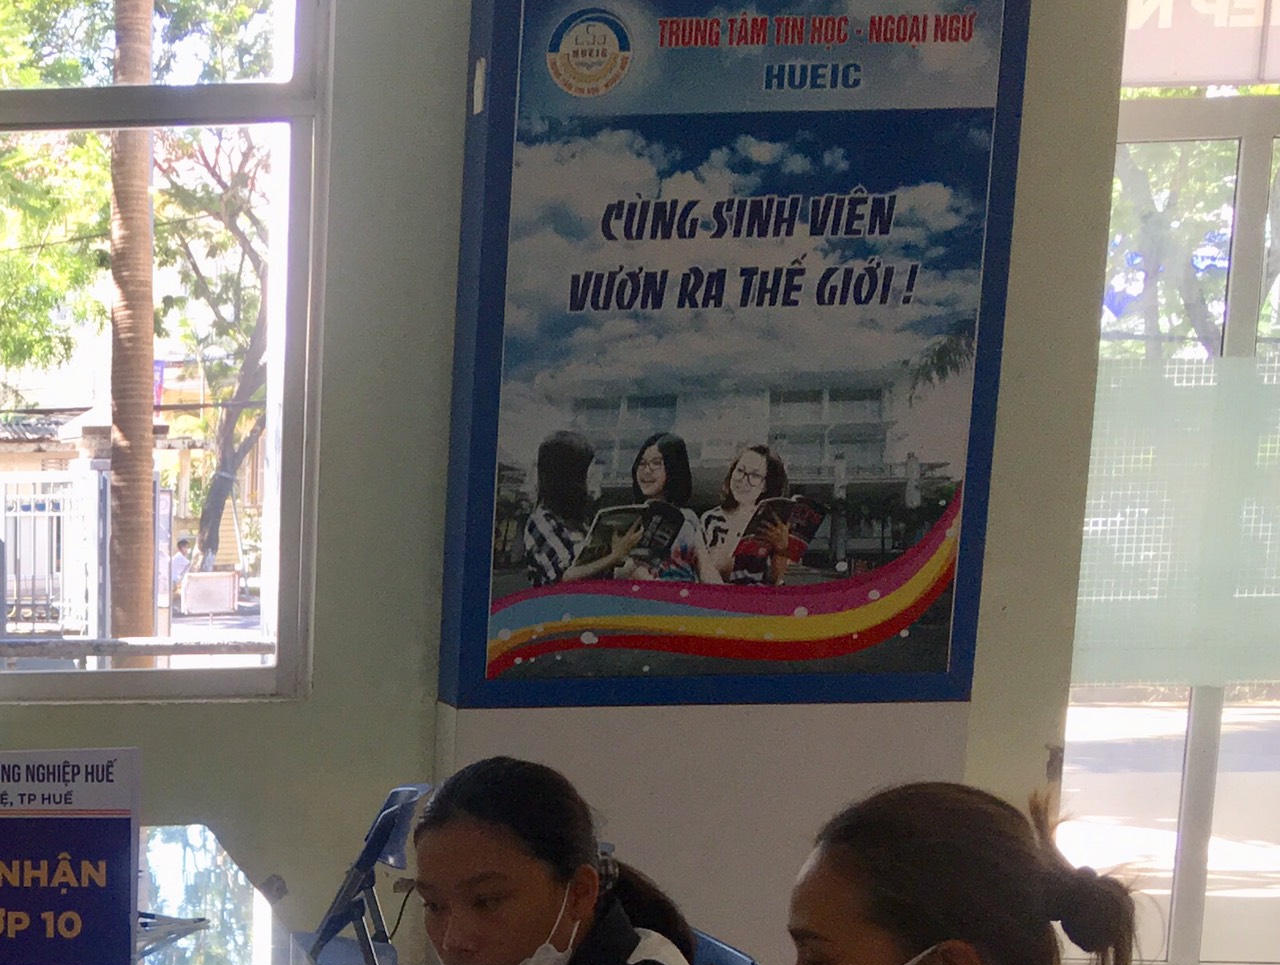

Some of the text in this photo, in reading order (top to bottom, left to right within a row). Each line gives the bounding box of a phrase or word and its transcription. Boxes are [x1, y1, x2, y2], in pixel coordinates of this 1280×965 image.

[658, 16, 721, 48] TRUNG
[727, 12, 768, 46] TÂM
[774, 16, 805, 46] TIN
[809, 16, 849, 51] HỌC
[868, 14, 929, 48] NGOẠI
[934, 7, 977, 43] NGỮ
[764, 63, 862, 90] HUEIC
[601, 185, 896, 242] CÙNG SINH VIÊN
[677, 266, 727, 309] RA
[739, 253, 807, 308] THẾ
[816, 257, 893, 306] GIỚI
[26, 760, 81, 787] NGHIỆP
[85, 758, 117, 782] HUẾ
[18, 793, 36, 805] TP
[42, 790, 74, 805] HUẾ
[41, 910, 82, 938] 10
